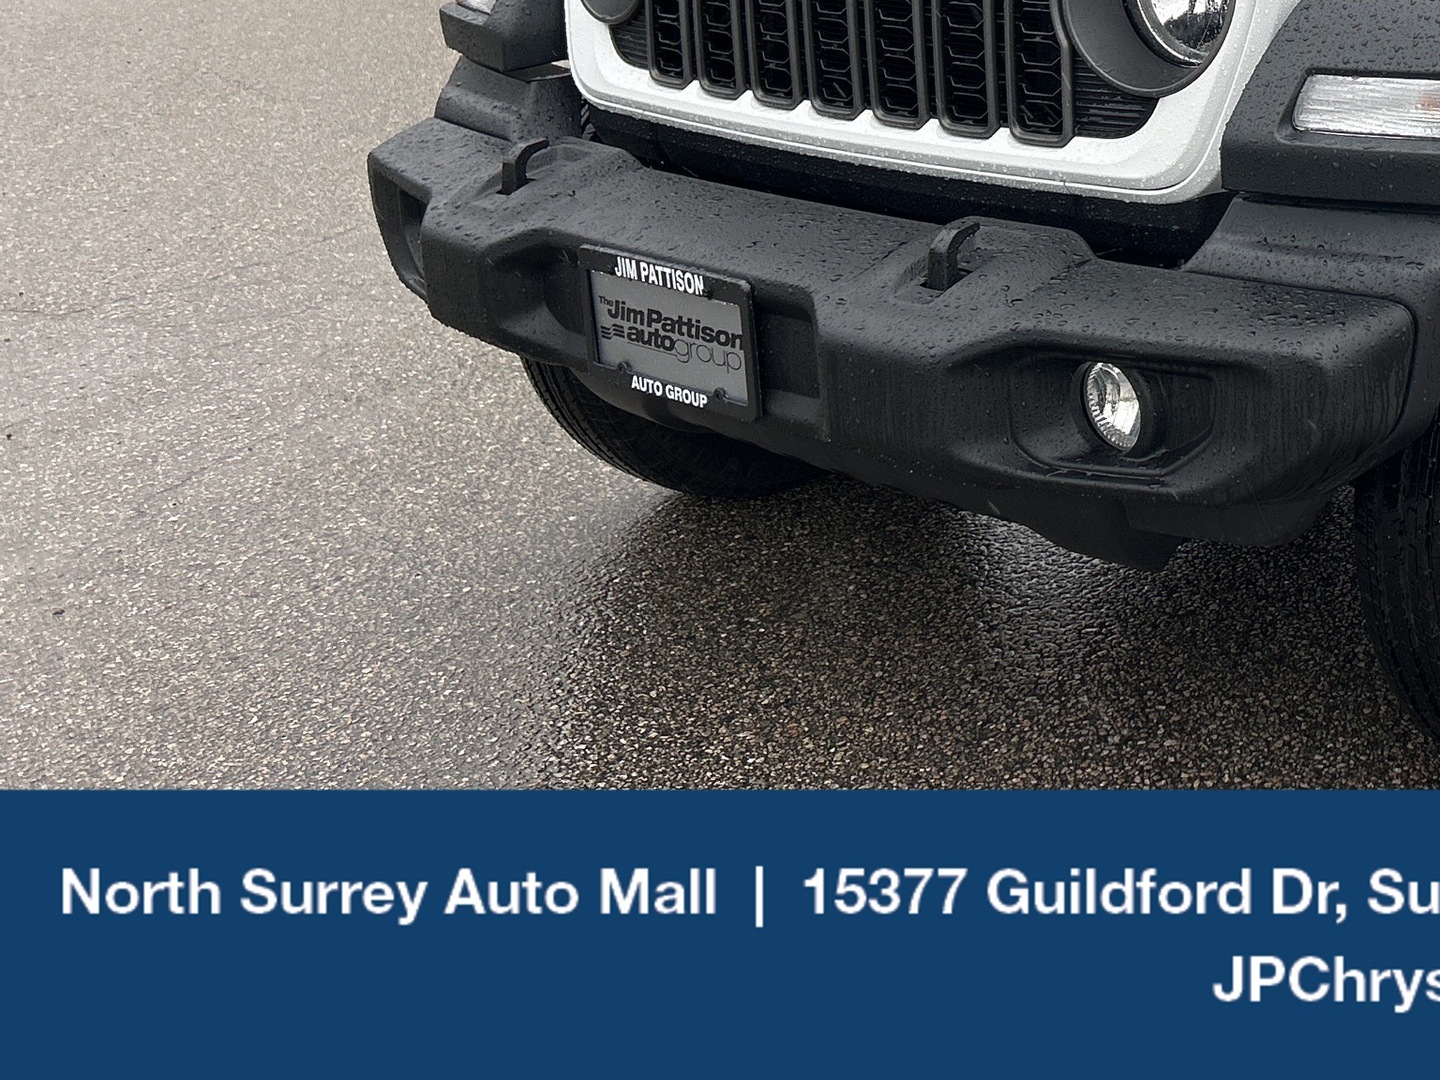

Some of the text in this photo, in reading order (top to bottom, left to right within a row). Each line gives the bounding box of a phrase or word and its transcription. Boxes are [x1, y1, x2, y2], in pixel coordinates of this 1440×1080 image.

[614, 256, 704, 295] JIM PATTISON
[599, 295, 614, 308] The
[631, 374, 708, 408] AUTO GROUP
